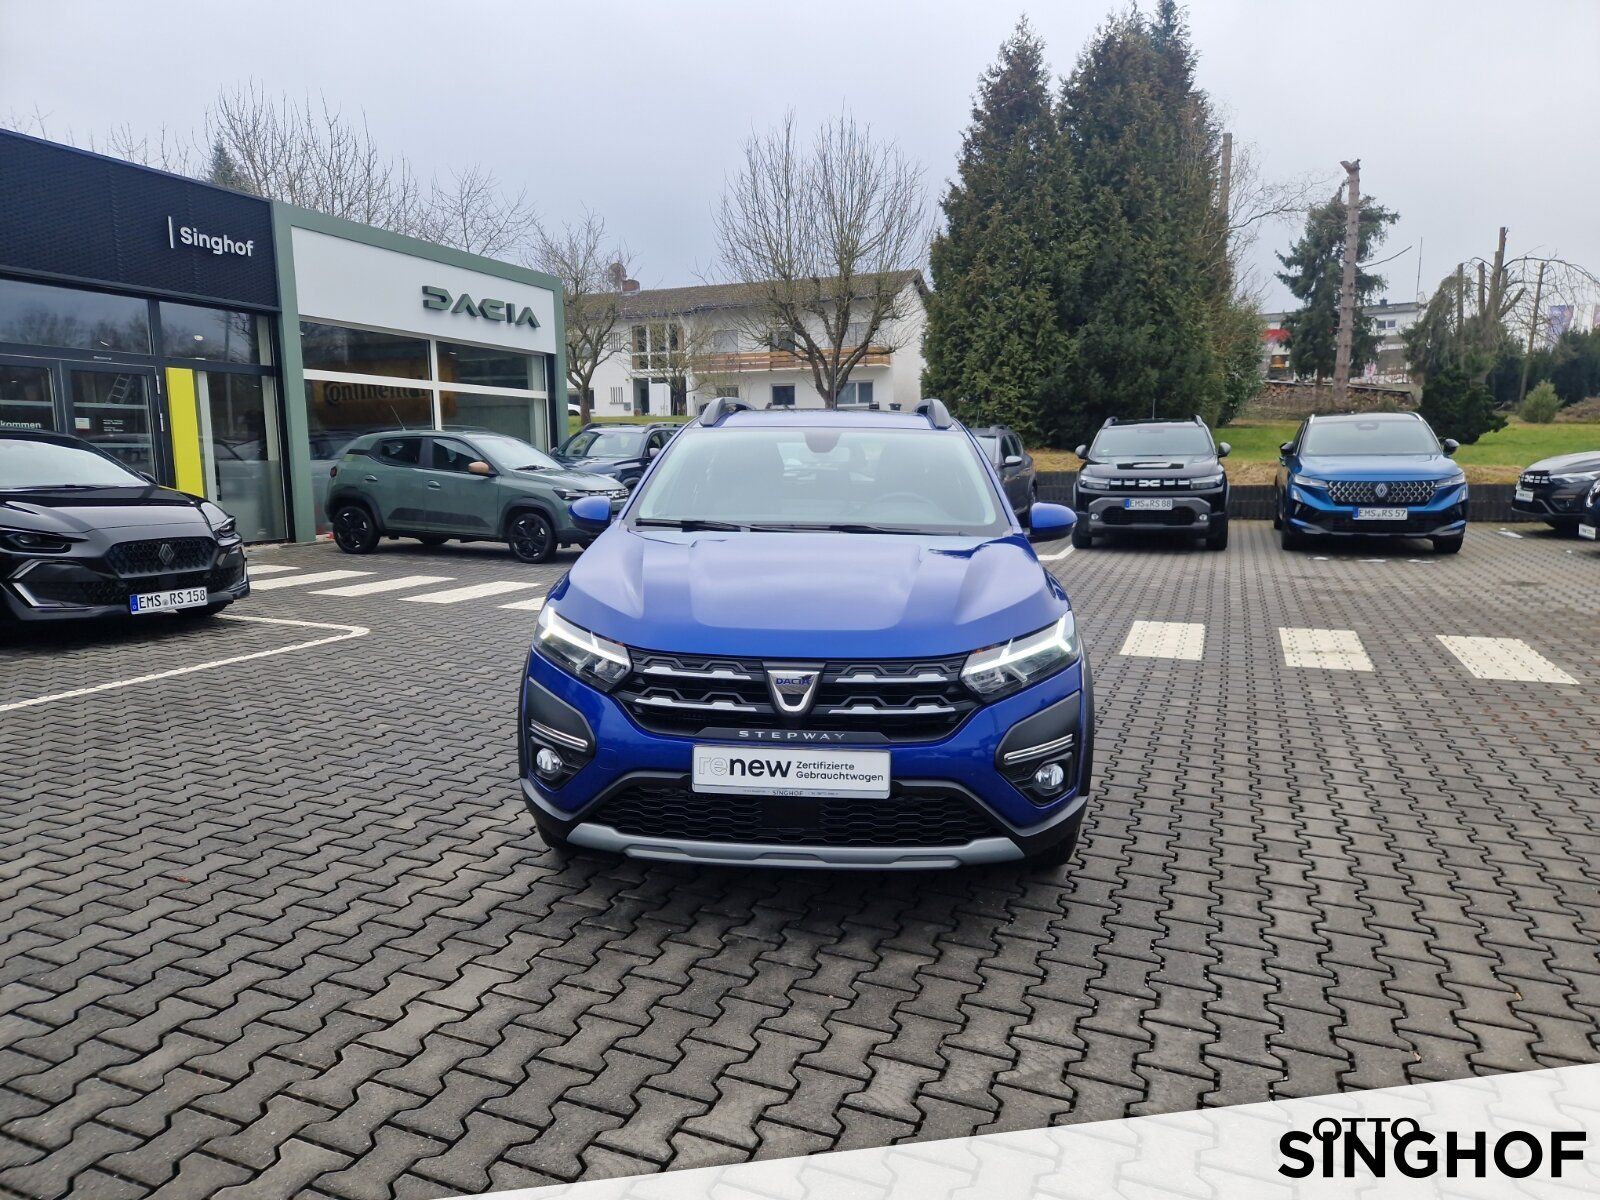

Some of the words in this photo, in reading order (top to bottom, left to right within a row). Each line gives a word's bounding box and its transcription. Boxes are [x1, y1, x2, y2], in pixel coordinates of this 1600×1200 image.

[180, 226, 254, 256] Singhof
[422, 285, 541, 328] DACIA
[1130, 500, 1145, 508] EMS
[1151, 500, 1160, 508] RS
[1358, 509, 1376, 517] EMS
[1382, 509, 1393, 517] RS
[1395, 509, 1406, 517] 57
[139, 594, 162, 609] EMS
[169, 592, 184, 606] RS
[187, 589, 206, 603] 158
[776, 677, 810, 685] DACIA
[739, 730, 845, 740] STEPWAY
[796, 761, 855, 771] Zertifizierte
[796, 771, 884, 783] Gebrauchtwagen
